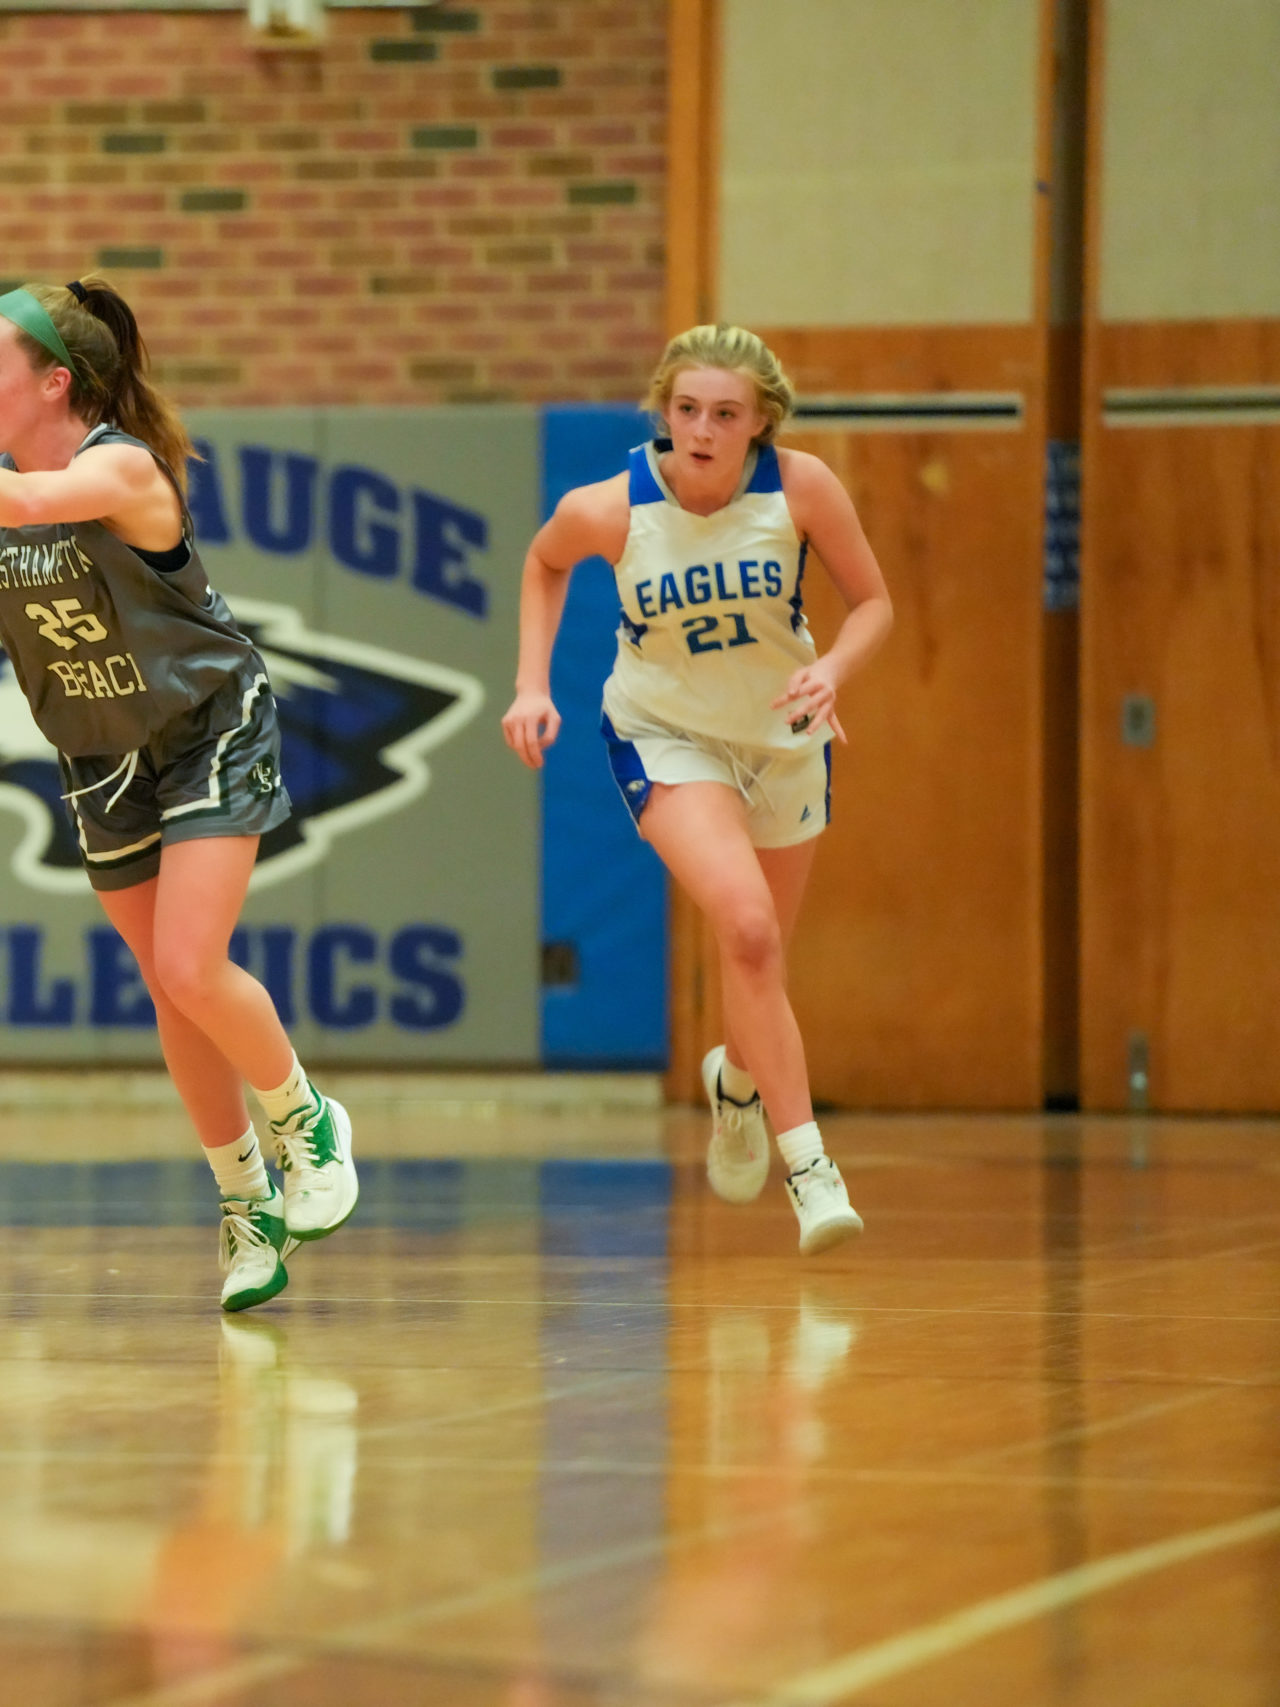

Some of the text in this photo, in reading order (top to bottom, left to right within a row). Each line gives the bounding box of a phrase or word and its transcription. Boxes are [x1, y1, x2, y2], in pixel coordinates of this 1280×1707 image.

[635, 559, 783, 619] EAGLES
[24, 598, 109, 651] 25
[681, 613, 759, 657] 21
